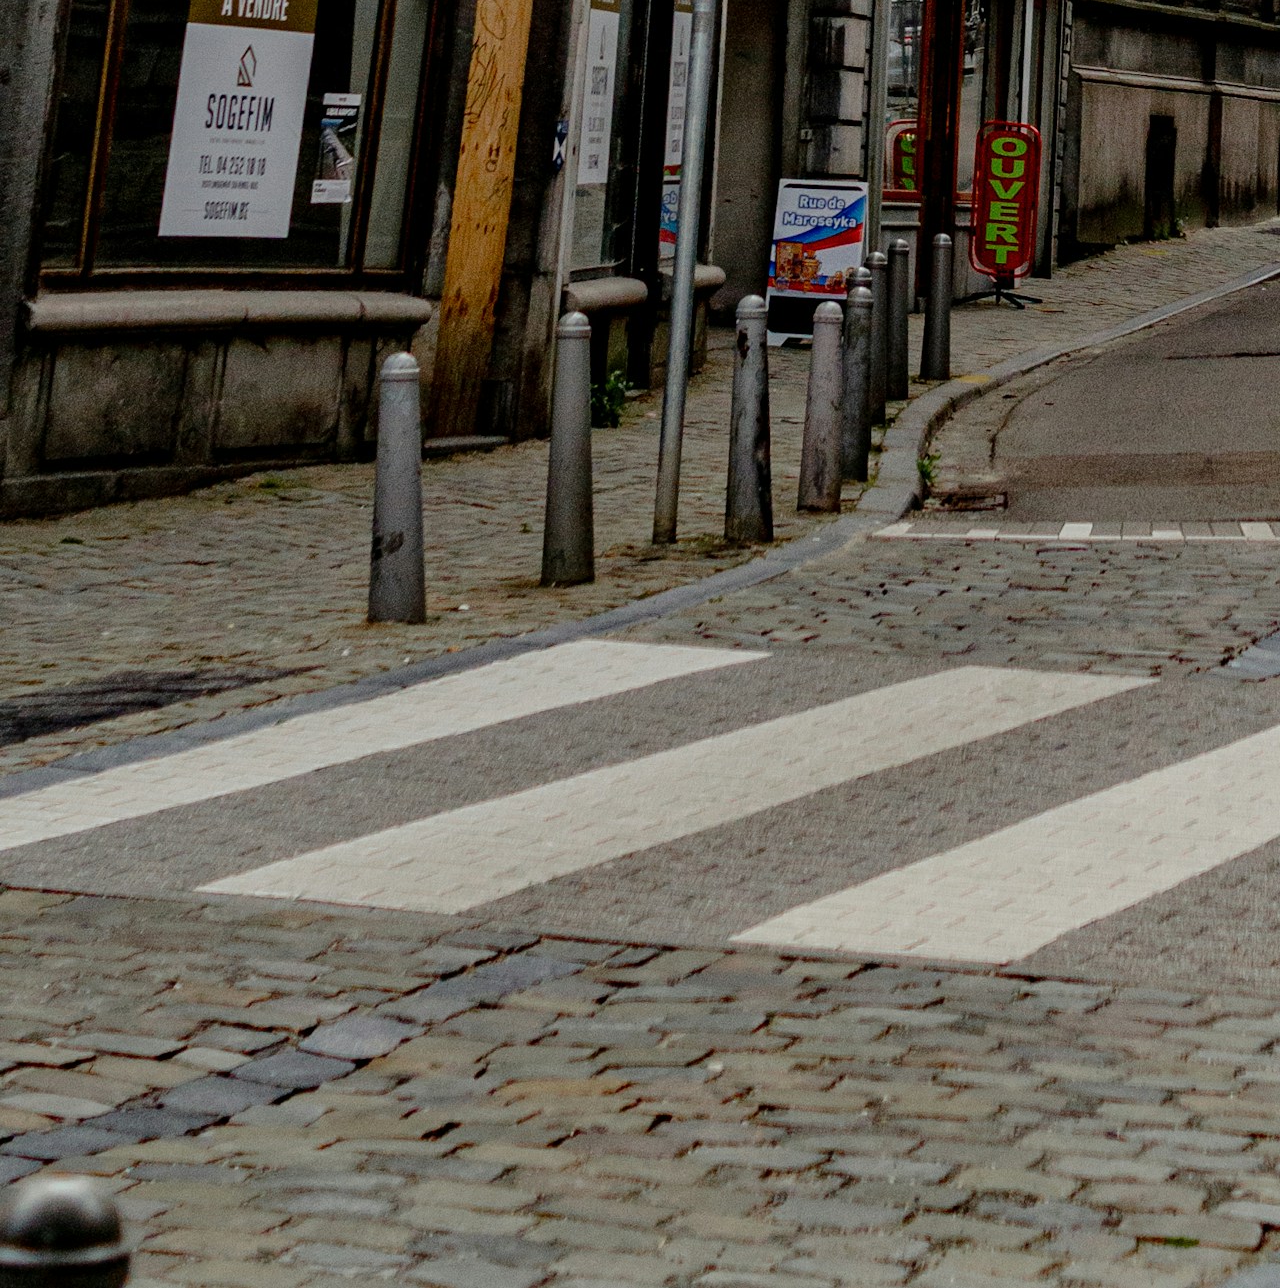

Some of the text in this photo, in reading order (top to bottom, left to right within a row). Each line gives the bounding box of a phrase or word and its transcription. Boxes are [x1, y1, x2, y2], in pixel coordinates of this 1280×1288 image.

[205, 93, 275, 132] SOGEFIM
[216, 156, 228, 174] 04
[229, 156, 244, 175] 252
[798, 194, 846, 210] Rue de
[985, 136, 1027, 264] OUVERT
[204, 201, 250, 220] SOGEFIM.BE
[783, 211, 857, 229] Maroseyka
